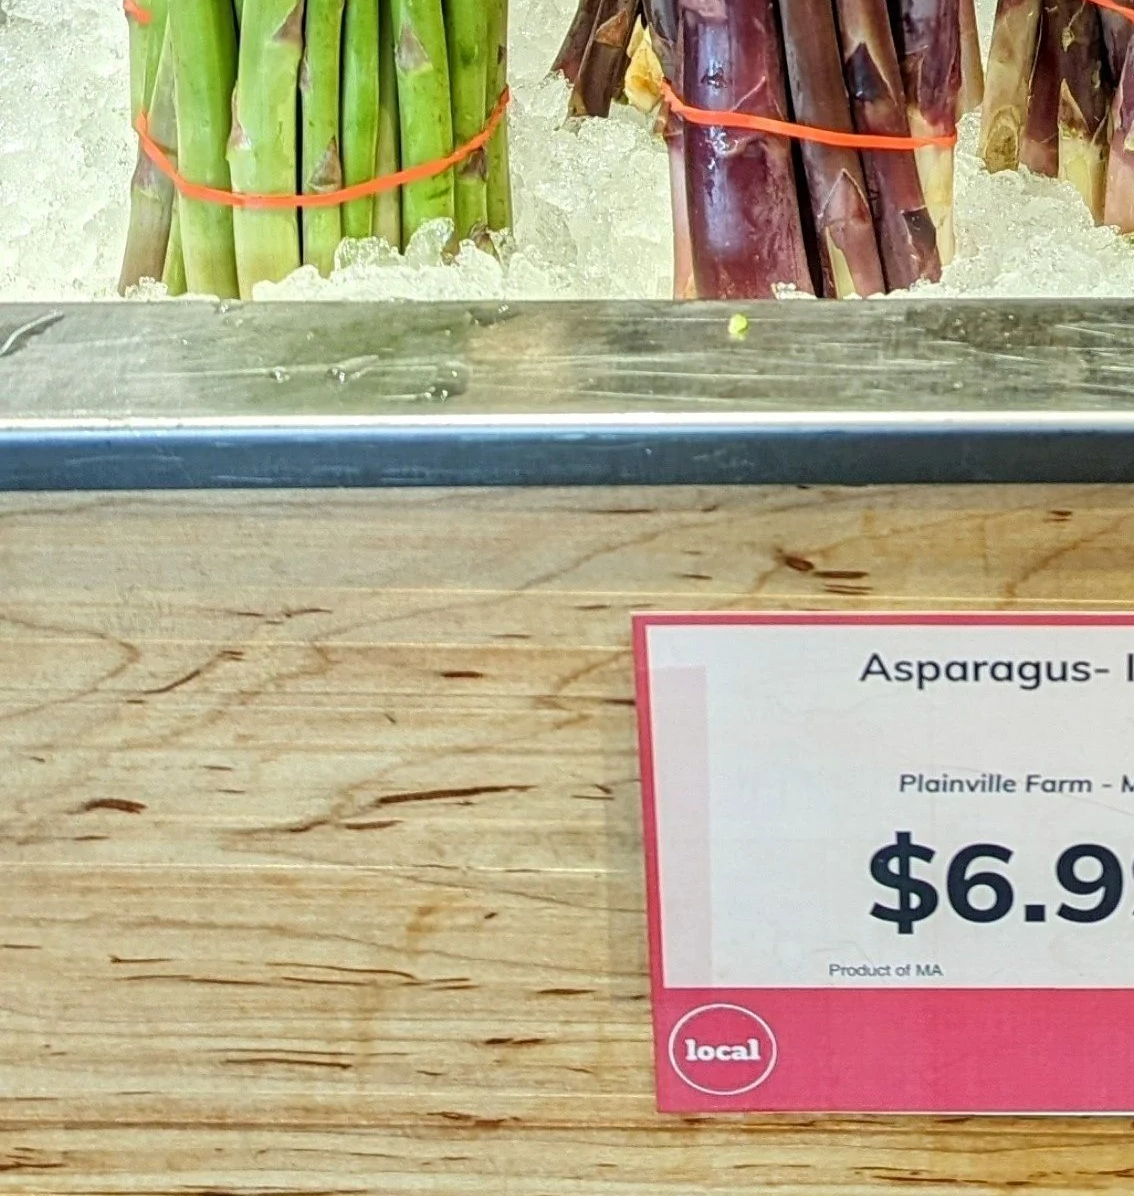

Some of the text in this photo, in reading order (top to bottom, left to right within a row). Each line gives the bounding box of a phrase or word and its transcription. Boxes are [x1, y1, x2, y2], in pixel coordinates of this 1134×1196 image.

[860, 653, 1110, 691] Asparagus-
[899, 772, 1016, 793] Plainville
[1025, 773, 1092, 793] Farm
[828, 962, 944, 977] Product of MA
[684, 1038, 761, 1061] local
